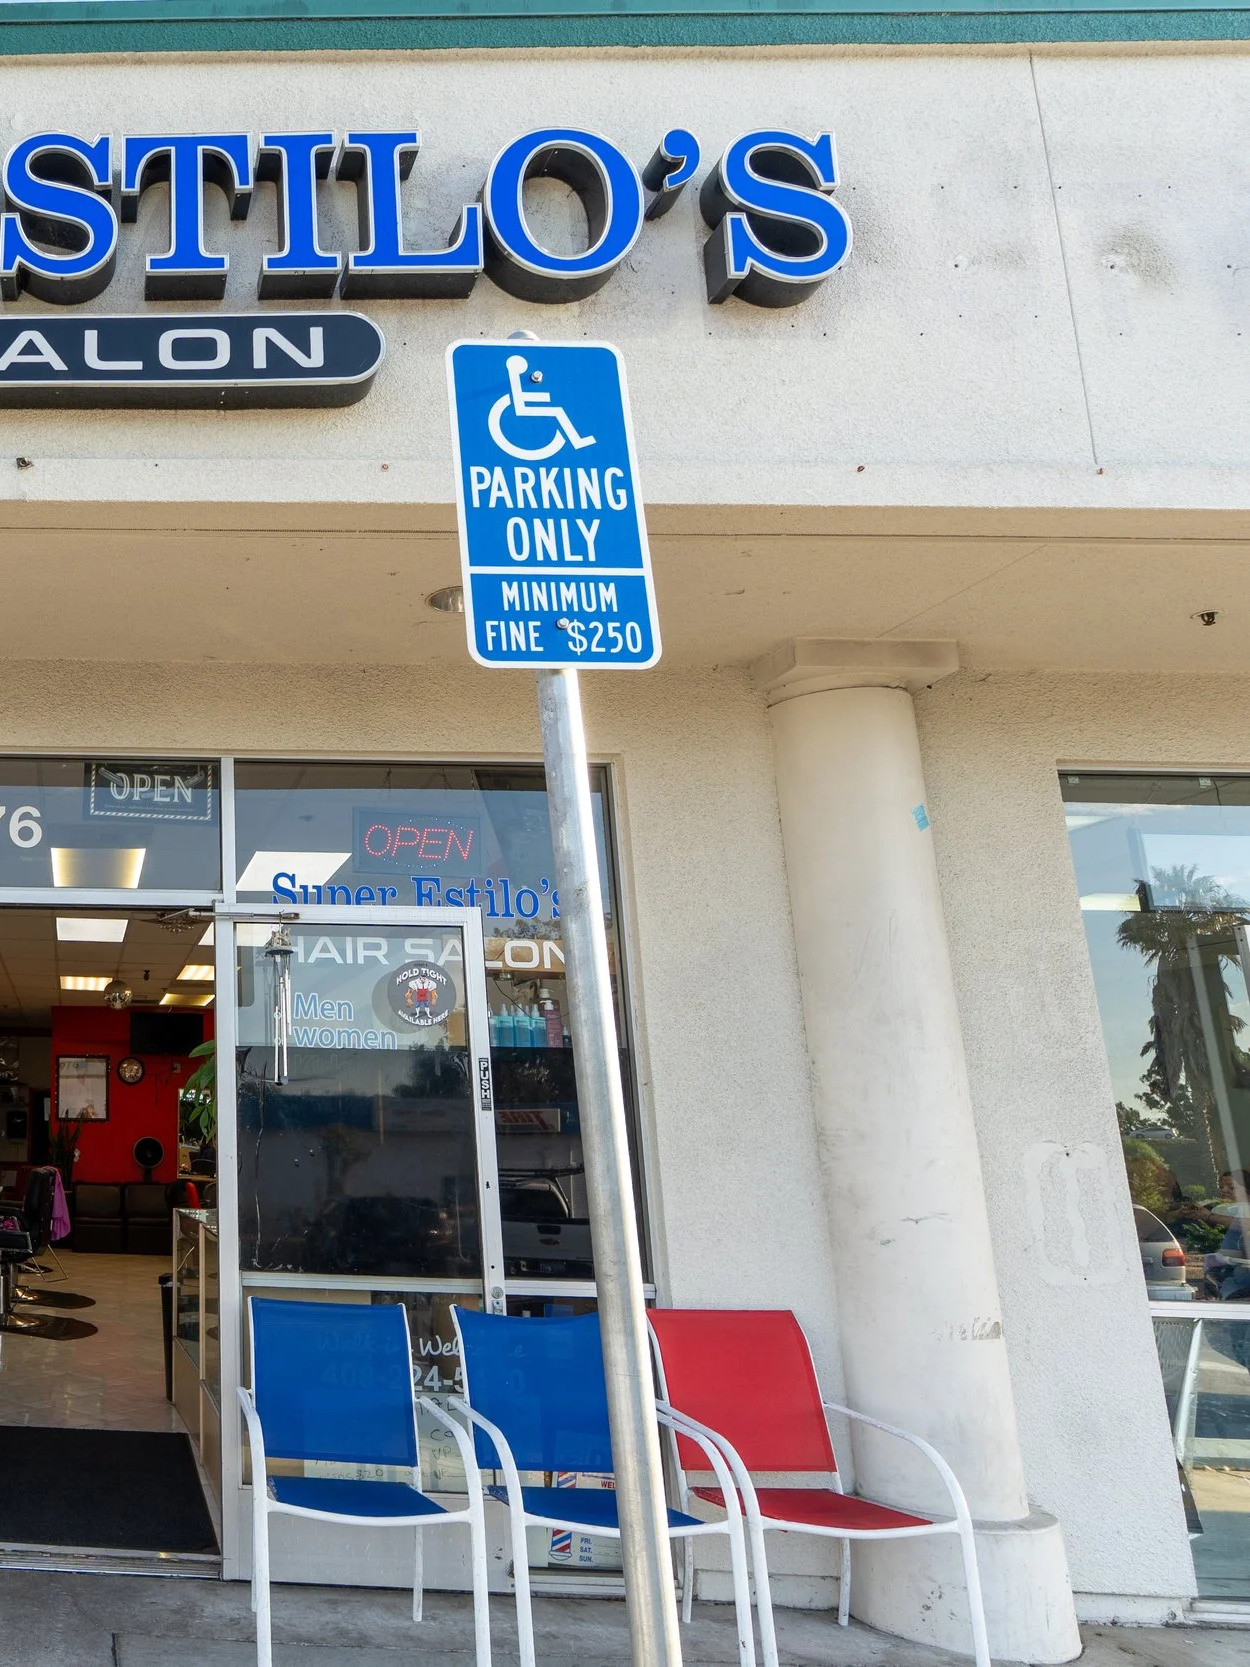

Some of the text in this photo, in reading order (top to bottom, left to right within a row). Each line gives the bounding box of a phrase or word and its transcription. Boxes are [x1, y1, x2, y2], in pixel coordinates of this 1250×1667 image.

[469, 466, 628, 511] PARKING
[506, 517, 600, 562] ONLY
[501, 581, 618, 613] MINIMUM
[486, 619, 642, 656] FINE $250
[110, 773, 192, 803] OPEN
[364, 824, 474, 861] OPEN
[396, 967, 447, 985] HOLD TIGHT
[293, 992, 354, 1021] Men
[398, 1009, 449, 1026] AVAILABLE HERE
[293, 1026, 398, 1050] women
[480, 1061, 491, 1099] PUSH
